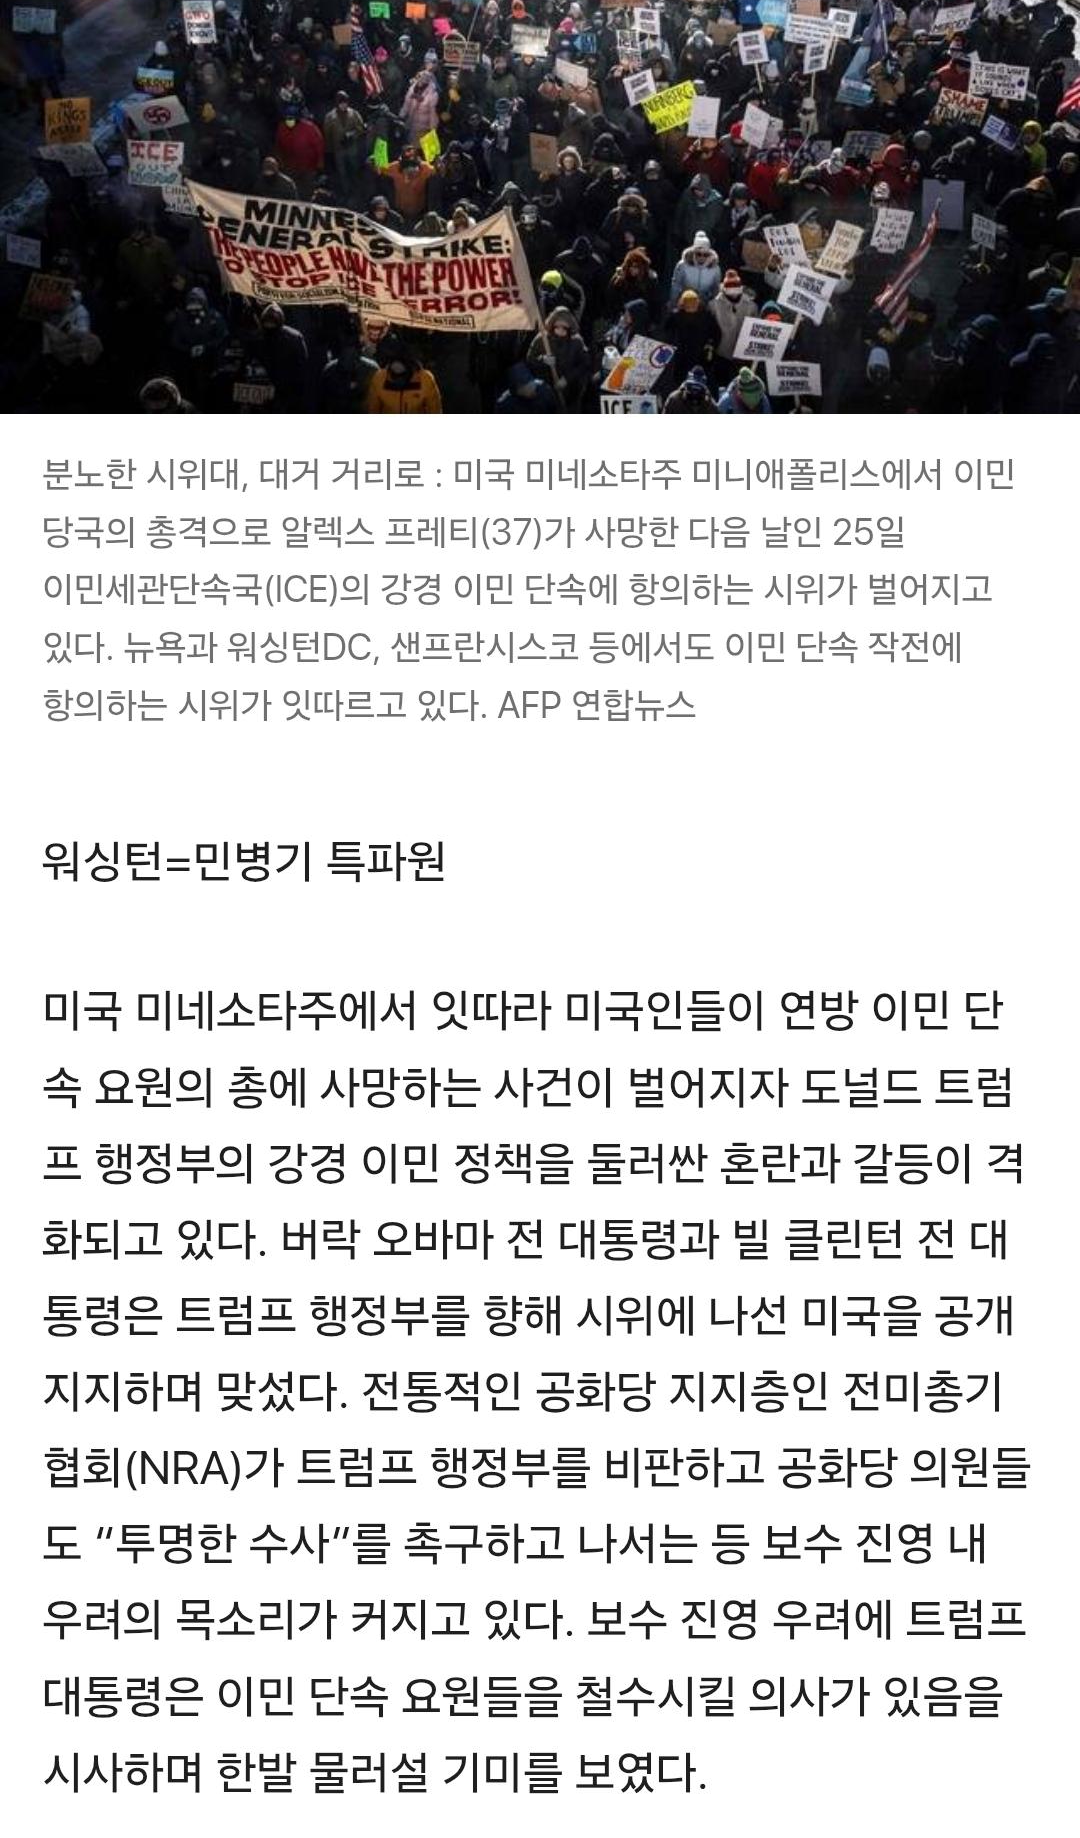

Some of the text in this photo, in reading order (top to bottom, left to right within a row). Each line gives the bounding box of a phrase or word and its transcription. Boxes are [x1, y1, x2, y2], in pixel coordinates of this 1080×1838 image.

[942, 89, 986, 111] SHAME
[131, 142, 178, 162] ICE
[240, 247, 330, 276] PEOPLE
[383, 262, 428, 297] THE
[433, 258, 518, 294] POWER
[43, 458, 1013, 492] 분노한 시위대, 대거 거리로 : 미국 미네소타주 미니애폴리스에서 이민
[44, 516, 903, 550] 당국의 총격으로 알렉스 프레티(37)가 사망한 다음 날인 25일
[45, 573, 992, 607] 이민세관단속국(ICE)의 강경 이민 단속에 항의하는 시위가 벌어지고
[45, 631, 960, 665] 있다. 뉴욕과 워싱턴DC, 샌프란시스코 등에서도 이민 단속 작전에
[44, 690, 696, 722] 항의하는 시위가 잇따르고 있다. AFP 연합뉴스
[42, 841, 444, 883] 워싱턴=민병기 특파원
[46, 990, 1003, 1032] 미국 미네소타주에서 잇따라 미국인들이 연방 이민 단
[44, 1752, 706, 1794] 시사하며 한발 물러설 기미를 보였다.
